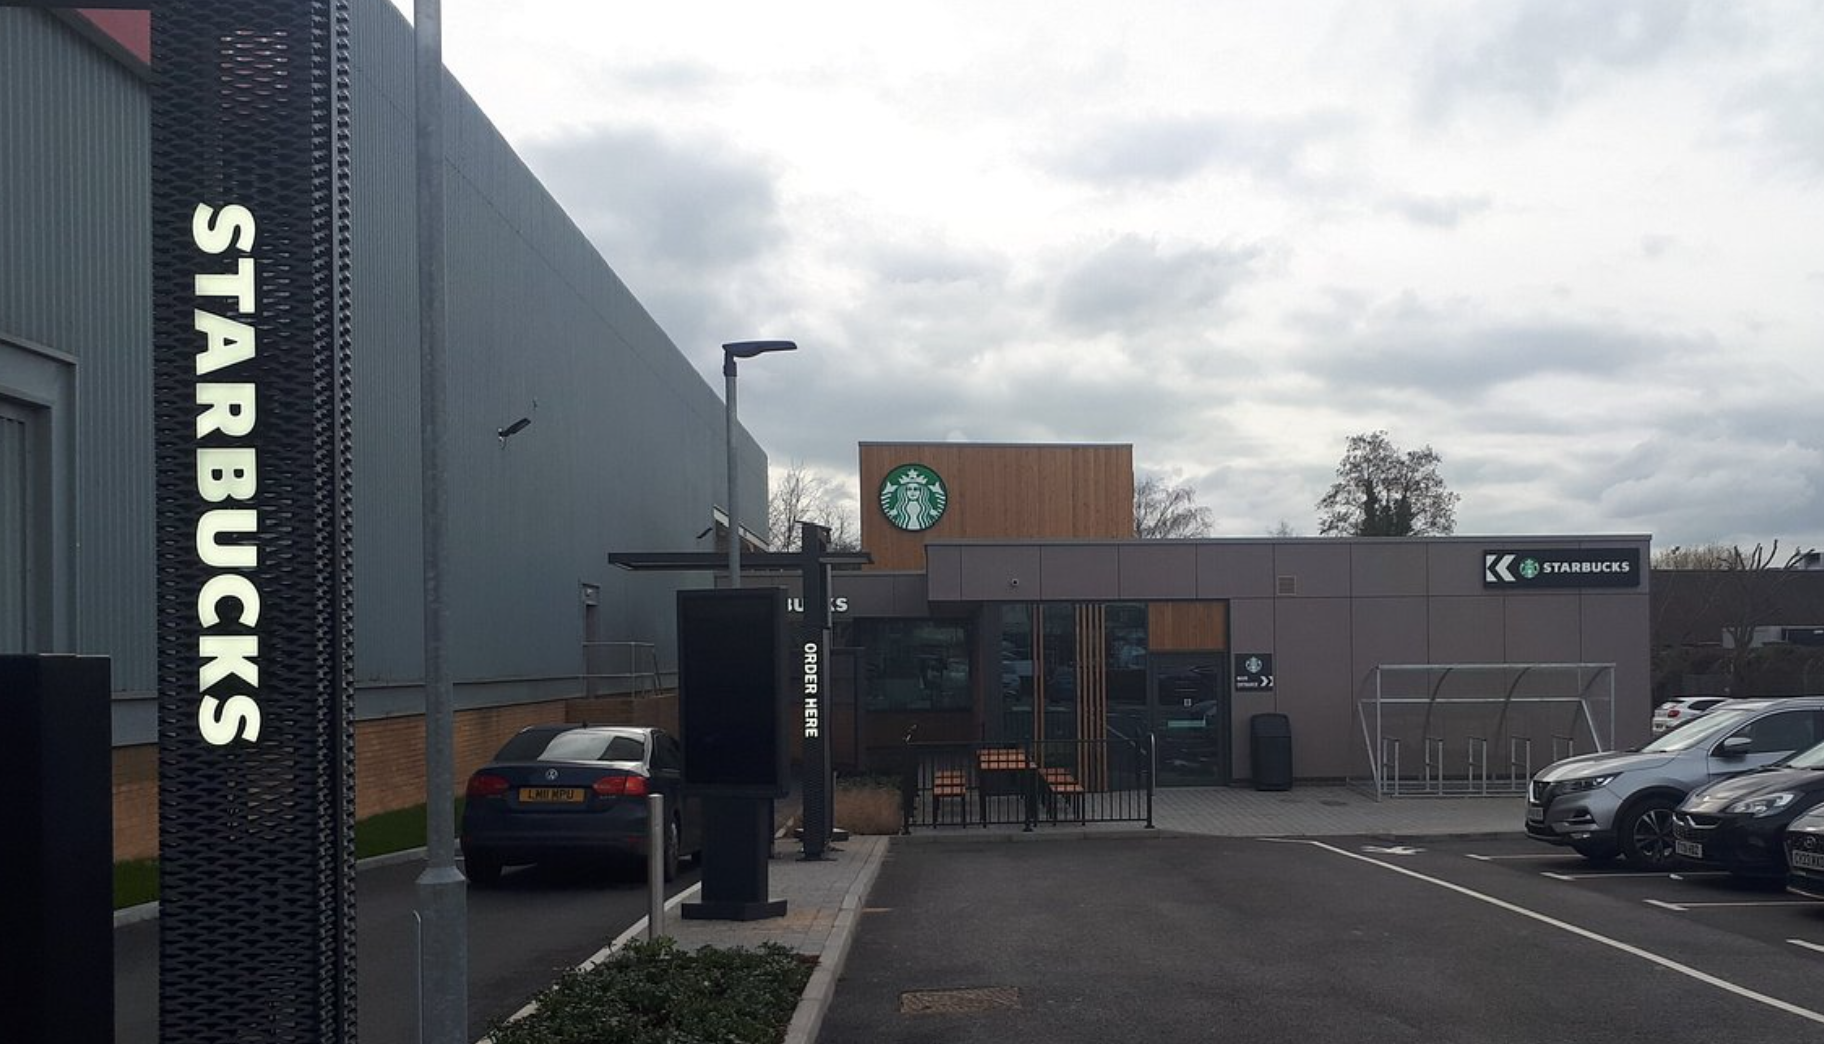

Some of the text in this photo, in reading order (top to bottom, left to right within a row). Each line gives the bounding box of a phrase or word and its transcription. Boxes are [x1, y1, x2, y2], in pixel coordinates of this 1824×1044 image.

[192, 203, 261, 745] STARBUCKS
[1543, 561, 1630, 573] STARBUCKS
[804, 643, 819, 738] ORDER HERE
